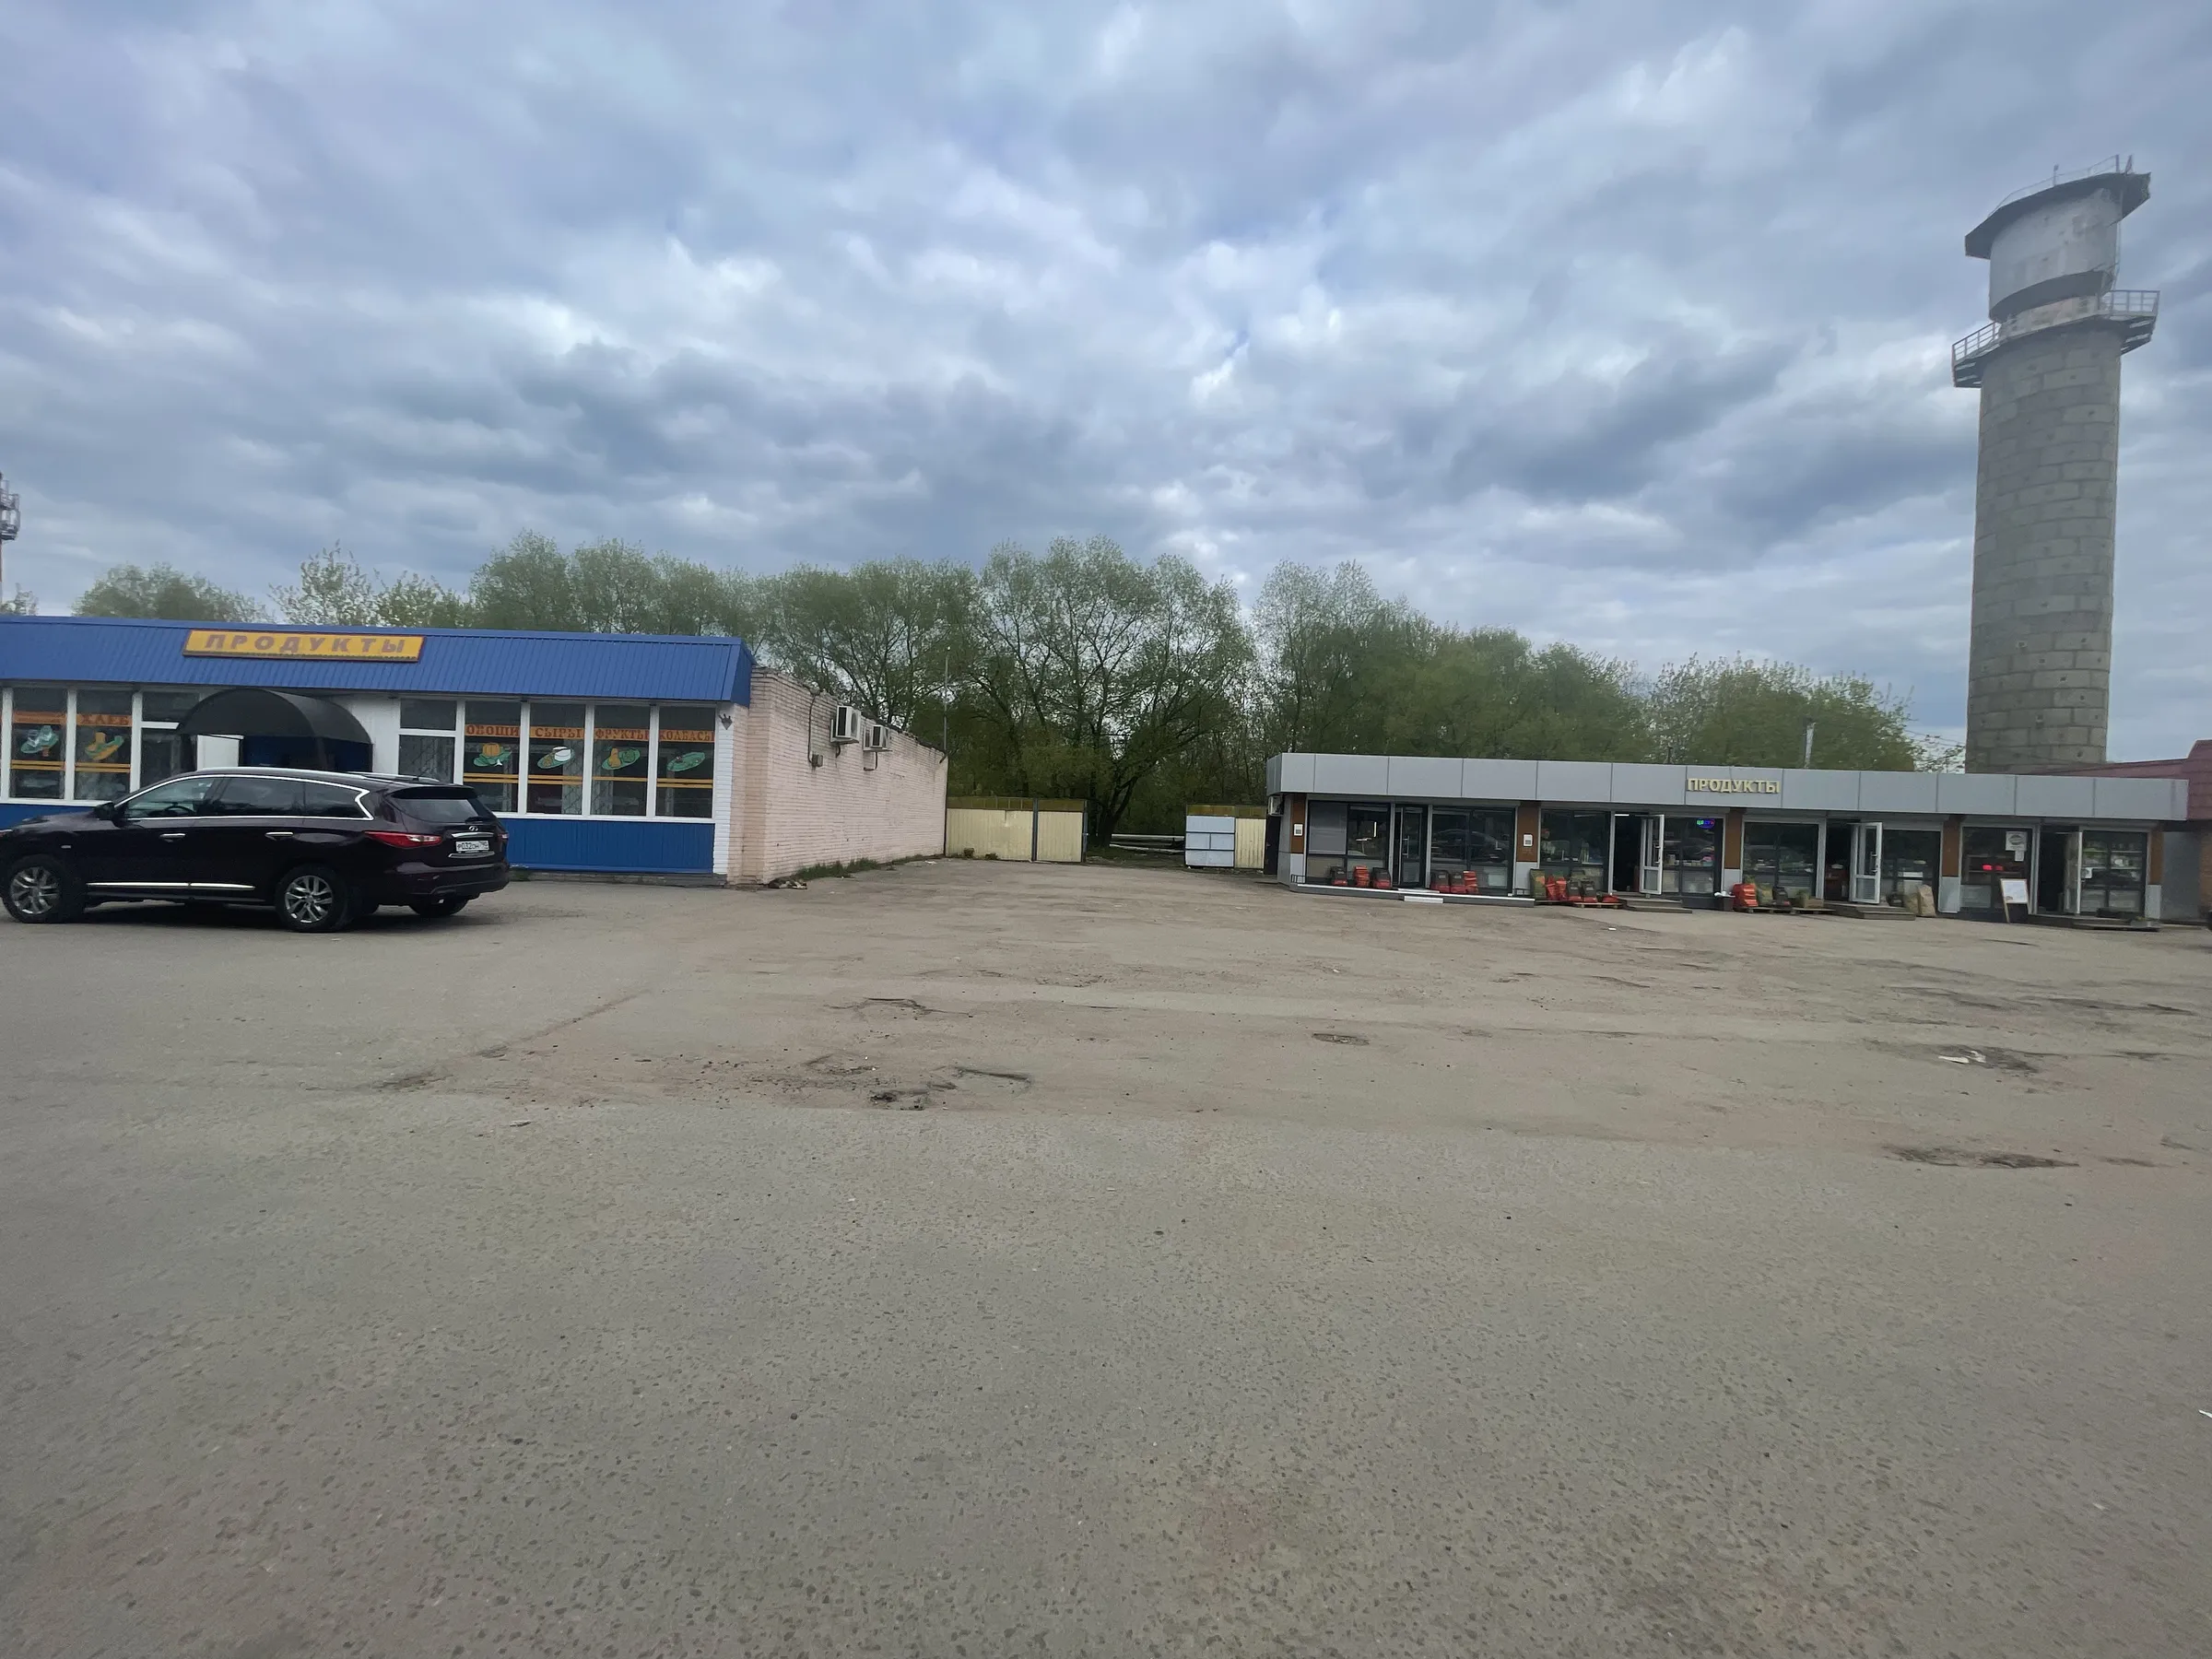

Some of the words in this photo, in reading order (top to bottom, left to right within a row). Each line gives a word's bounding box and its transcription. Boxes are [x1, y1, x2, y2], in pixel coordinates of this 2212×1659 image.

[204, 633, 406, 654] ПРОДУКТЫ
[535, 727, 582, 738] СЫРЫ
[1688, 778, 1781, 794] ПРОДУКТЫ
